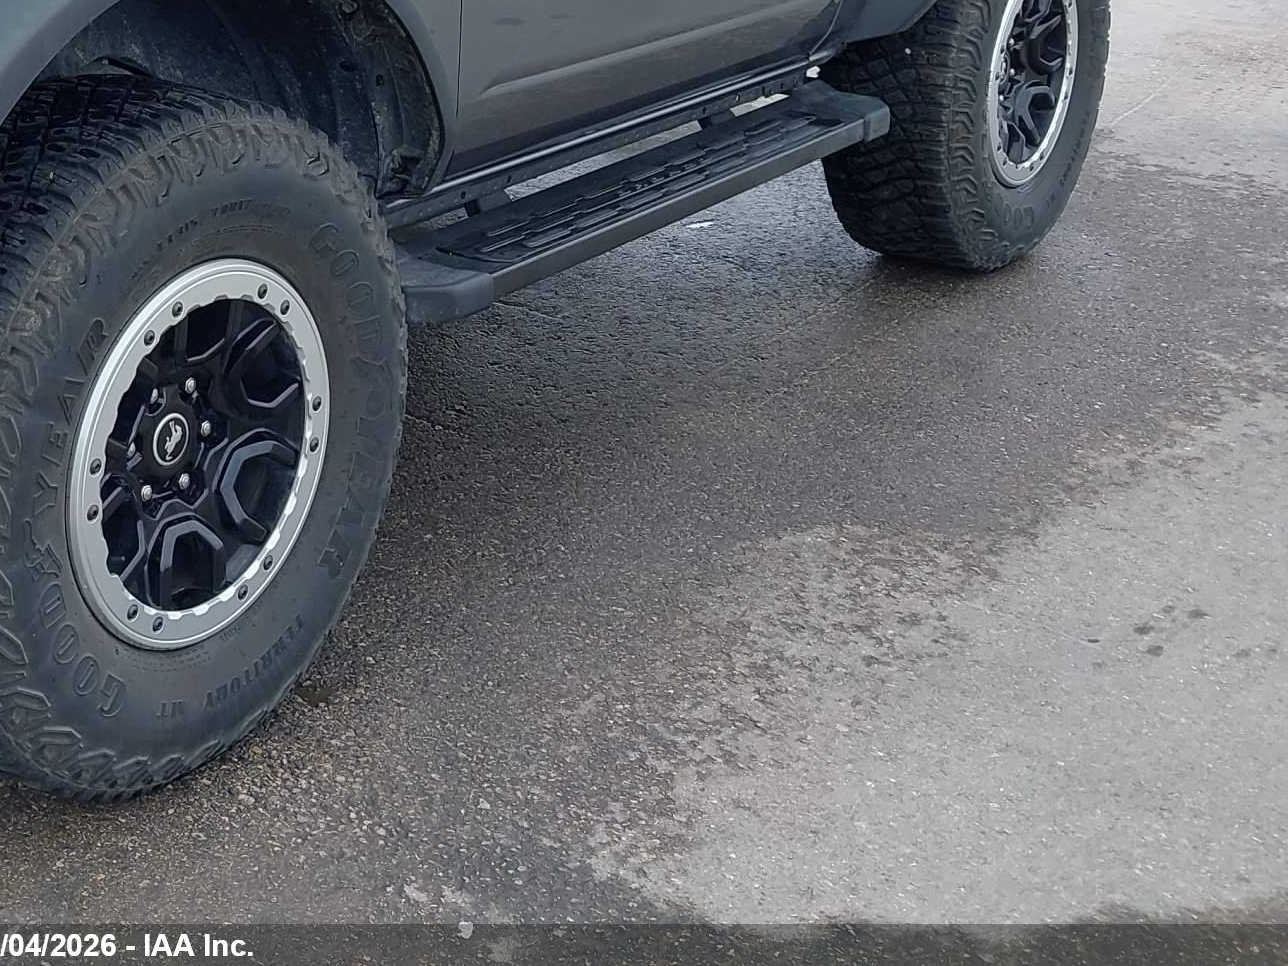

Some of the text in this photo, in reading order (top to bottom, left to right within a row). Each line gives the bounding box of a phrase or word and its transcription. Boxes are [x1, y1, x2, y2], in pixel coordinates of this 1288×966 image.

[23, 318, 126, 717] GOODYEAR
[308, 222, 393, 579] GOODYEAR
[205, 612, 305, 711] TERRITORY
